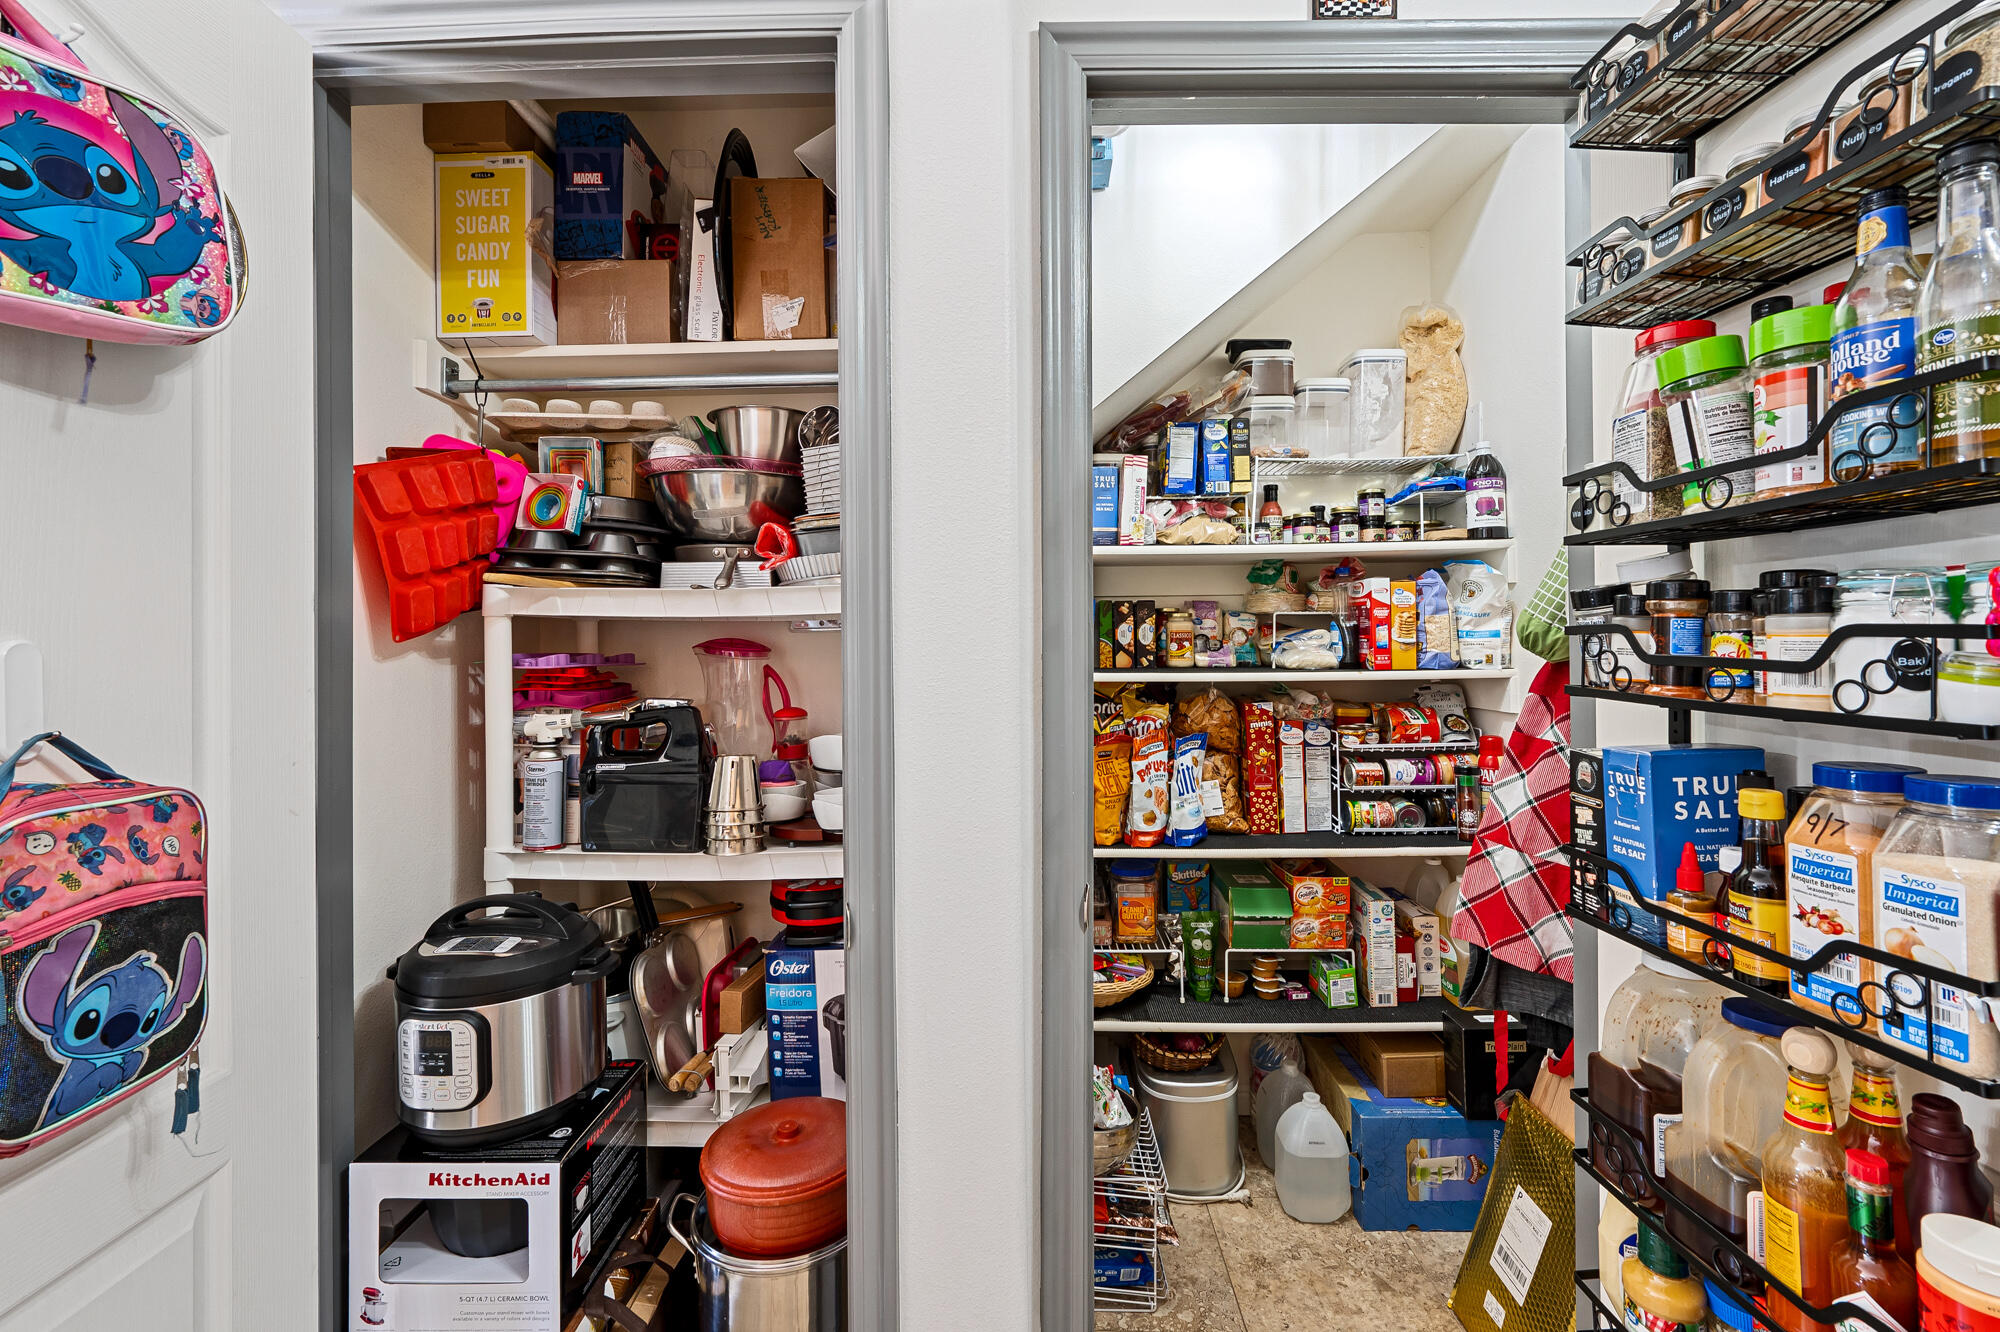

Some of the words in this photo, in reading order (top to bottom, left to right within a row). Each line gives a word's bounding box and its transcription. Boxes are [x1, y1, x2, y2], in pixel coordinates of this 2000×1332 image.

[1673, 20, 1692, 42] Basil
[573, 172, 603, 184] MARVEL
[1769, 163, 1806, 187] Harissa
[455, 188, 511, 207] SWEET
[1714, 196, 1741, 214] Grod
[1712, 202, 1742, 223] Musrd
[455, 215, 511, 234] SUGAR
[1656, 225, 1680, 241] Garam
[1654, 233, 1679, 250] Masala
[456, 242, 511, 261] CANDY
[467, 269, 500, 288] FUN
[697, 254, 705, 293] Electronic
[694, 295, 704, 316] glass
[694, 316, 704, 338] scale
[711, 310, 720, 339] TAYLOR
[1915, 352, 1965, 375] ASONED
[1704, 405, 1728, 414] Nutrition
[1841, 407, 1874, 423] COOKING
[1876, 405, 1900, 416] WIE
[1626, 421, 1641, 430] Pepper
[1572, 508, 1593, 518] Waabi
[1710, 644, 1747, 658] Dash
[1898, 657, 1926, 666] Baki
[1094, 702, 1123, 715] orito
[1250, 720, 1272, 729] minis
[1480, 768, 1498, 782] PAM
[1608, 770, 1646, 789] TRUE
[1099, 775, 1126, 795] HEAT
[1674, 799, 1739, 820] SAL
[1807, 812, 1850, 845] 9/7
[1622, 837, 1646, 849] NATURAL
[1613, 845, 1627, 855] SEA
[1628, 848, 1646, 861] SALT
[1171, 869, 1207, 881] Skittles
[1794, 858, 1851, 881] Imperial
[1791, 873, 1819, 885] Mesquite
[1820, 880, 1856, 894] Barbecue
[1807, 885, 1834, 897] Seasoning
[1615, 890, 1632, 900] OSHER
[1886, 884, 1957, 911] Imperial
[1882, 902, 1927, 920] Granulated
[1928, 914, 1957, 927] Onion
[769, 959, 810, 976] Oster
[769, 987, 813, 998] Freidora
[586, 1089, 632, 1150] KitchenAid
[428, 1172, 550, 1186] KitchenAid
[1516, 1191, 1523, 1200] P
